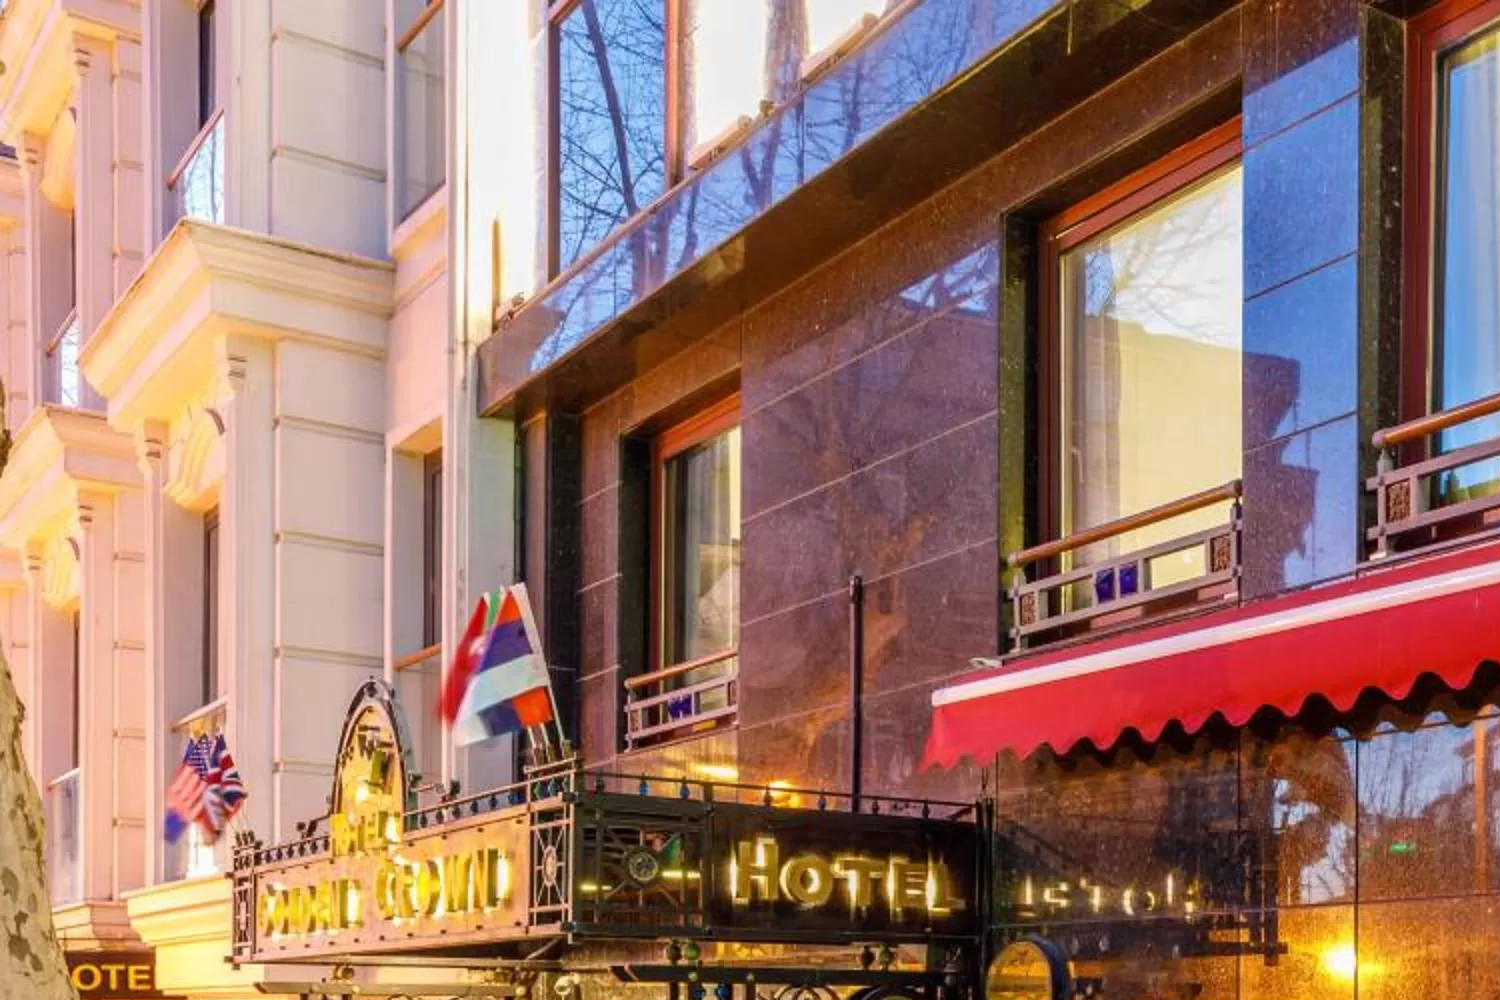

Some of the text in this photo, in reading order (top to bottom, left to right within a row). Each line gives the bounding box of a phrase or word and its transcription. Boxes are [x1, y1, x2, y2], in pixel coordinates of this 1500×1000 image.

[376, 847, 516, 924] CROWN
[730, 836, 968, 915] HOTEL
[71, 963, 151, 991] OTE
